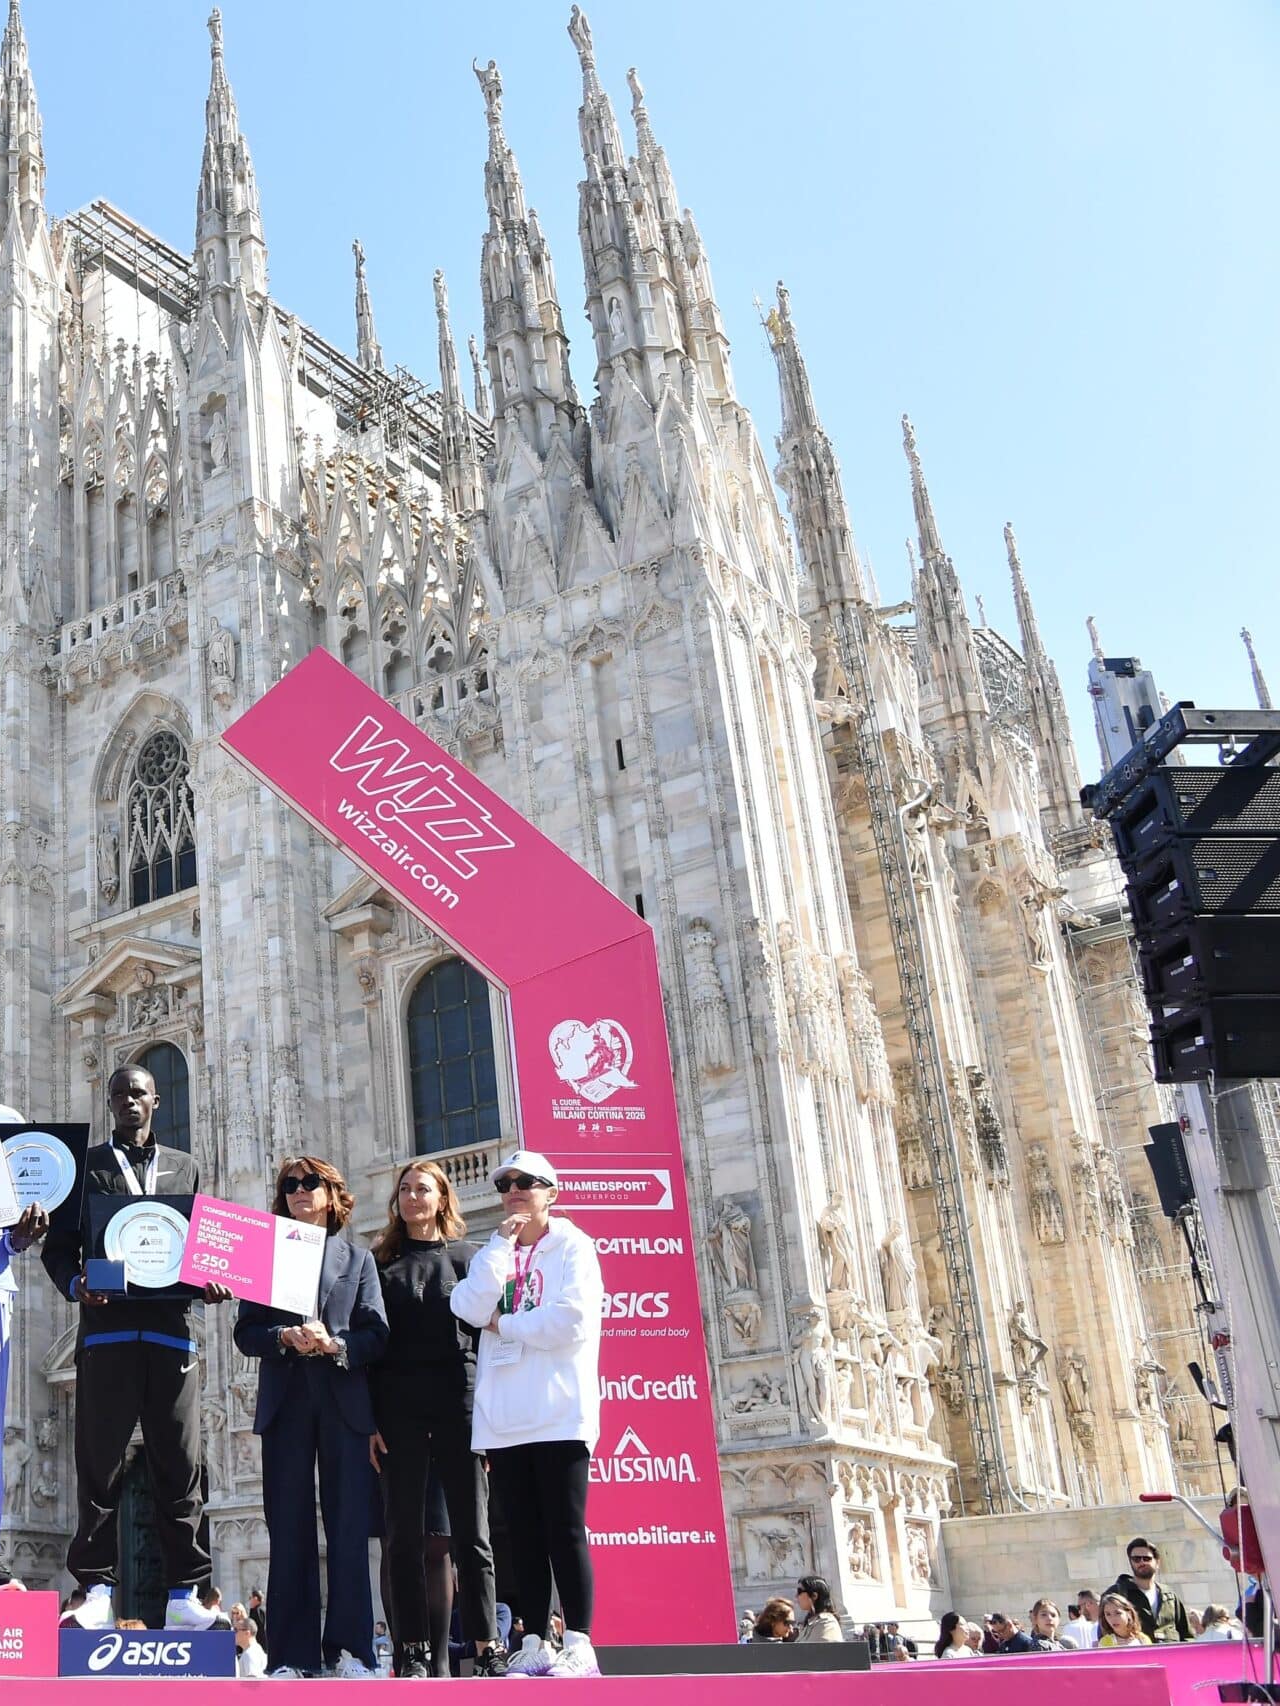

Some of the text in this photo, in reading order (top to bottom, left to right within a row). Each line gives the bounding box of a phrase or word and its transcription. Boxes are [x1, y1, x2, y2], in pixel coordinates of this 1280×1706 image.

[337, 797, 459, 909] wizzair.com
[553, 1111, 646, 1120] MILANO CORTINA 2026
[200, 1217, 222, 1228] MALE
[197, 1230, 231, 1245] RUNNER
[199, 1223, 244, 1241] MARATHON
[208, 1240, 234, 1253] PLACE
[595, 1237, 684, 1255] CATHLON
[191, 1263, 209, 1272] WIZZ
[221, 1271, 253, 1285] VOUCHER
[616, 1328, 637, 1337] mind
[639, 1328, 667, 1337] sound
[667, 1327, 691, 1338] body
[588, 1453, 696, 1483] EVISSIMA
[585, 1525, 716, 1546] mmobiliare.it
[3, 1627, 23, 1639] AIR
